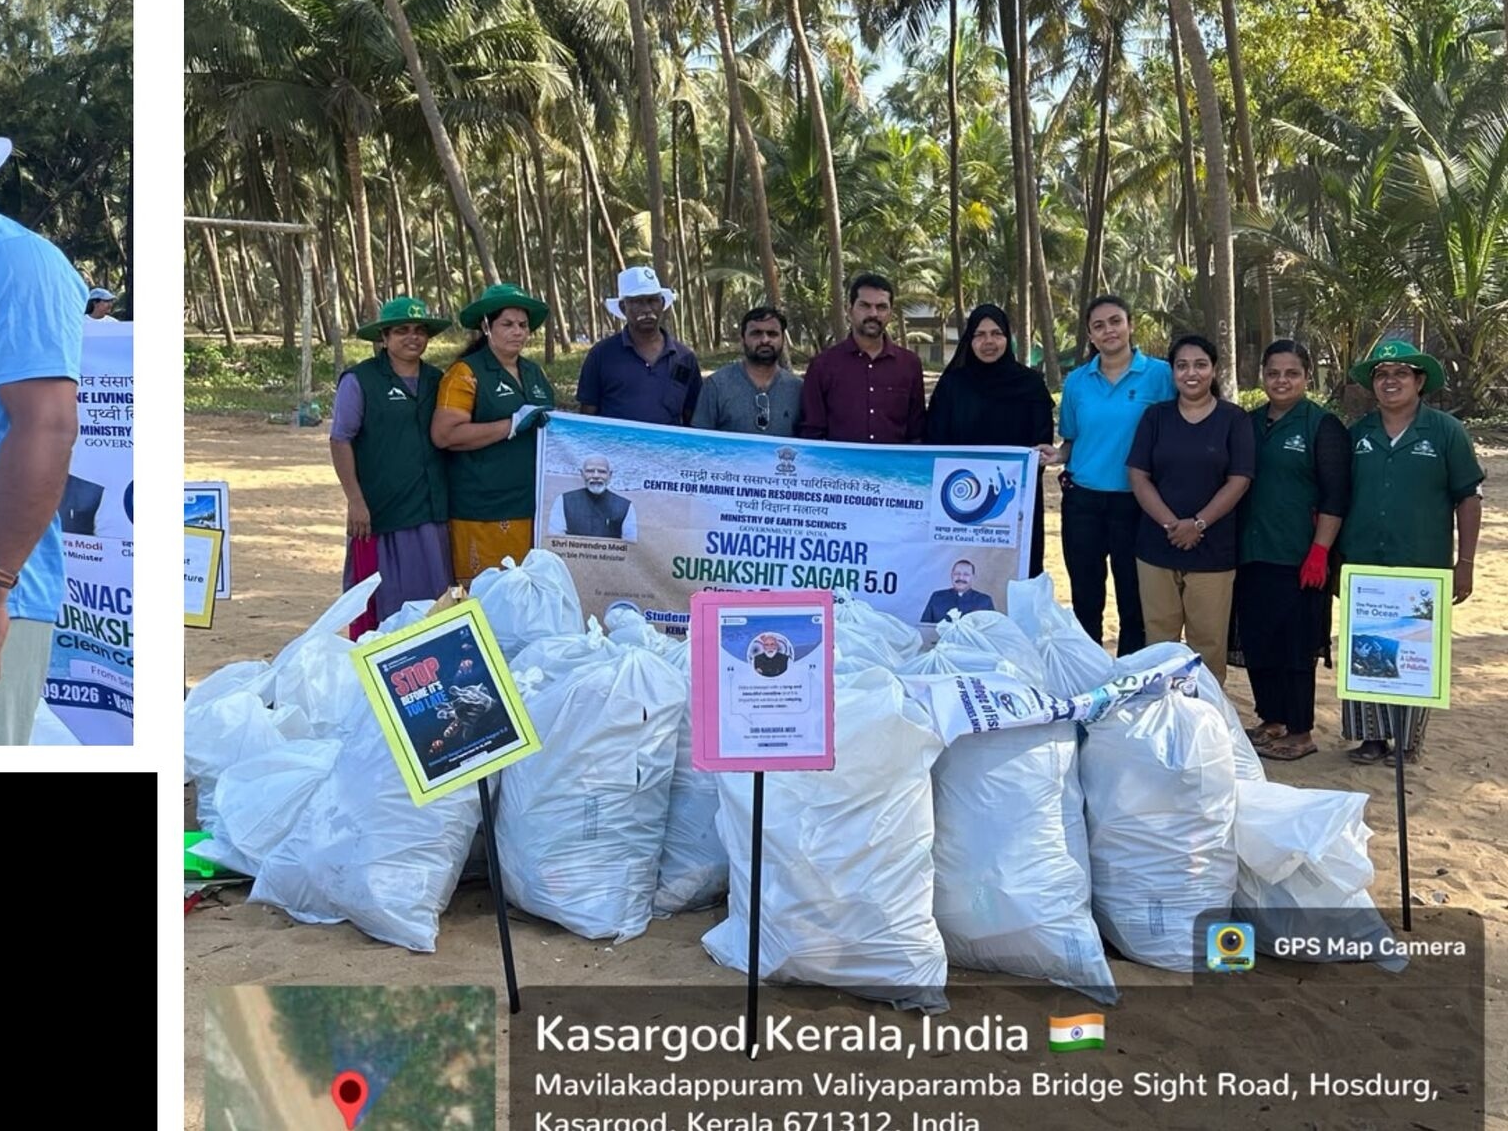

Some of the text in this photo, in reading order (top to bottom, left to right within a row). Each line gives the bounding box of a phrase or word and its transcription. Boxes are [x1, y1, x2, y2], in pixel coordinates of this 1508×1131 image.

[98, 374, 133, 388] संसा
[91, 392, 133, 404] LIVING
[80, 424, 132, 437] MINISTRY
[644, 479, 679, 492] CENTRE
[680, 482, 698, 494] FOR
[699, 484, 734, 496] MARINE
[736, 487, 767, 498] LIVING
[768, 489, 822, 502] RESOURCES
[823, 493, 842, 504] AND
[844, 494, 885, 508] ECOLOGY
[720, 513, 847, 531] MINISTRY OF EARTH SCIENCES
[75, 540, 103, 551] Modi
[551, 540, 628, 552] Shri Narendra Modi
[705, 530, 868, 566] SWACHH SAGAR
[68, 551, 103, 562] Minister
[672, 555, 898, 595] SURAKSHIT SAGAR 5.0
[67, 577, 133, 616] SWAC
[645, 610, 690, 623] Student
[1356, 608, 1399, 617] the Ocean
[665, 625, 688, 636] KERA
[56, 634, 111, 660] Clean
[91, 665, 118, 682] From
[391, 656, 440, 697] STOP
[401, 687, 429, 706] BEFORE
[405, 690, 448, 717] TOO LATE
